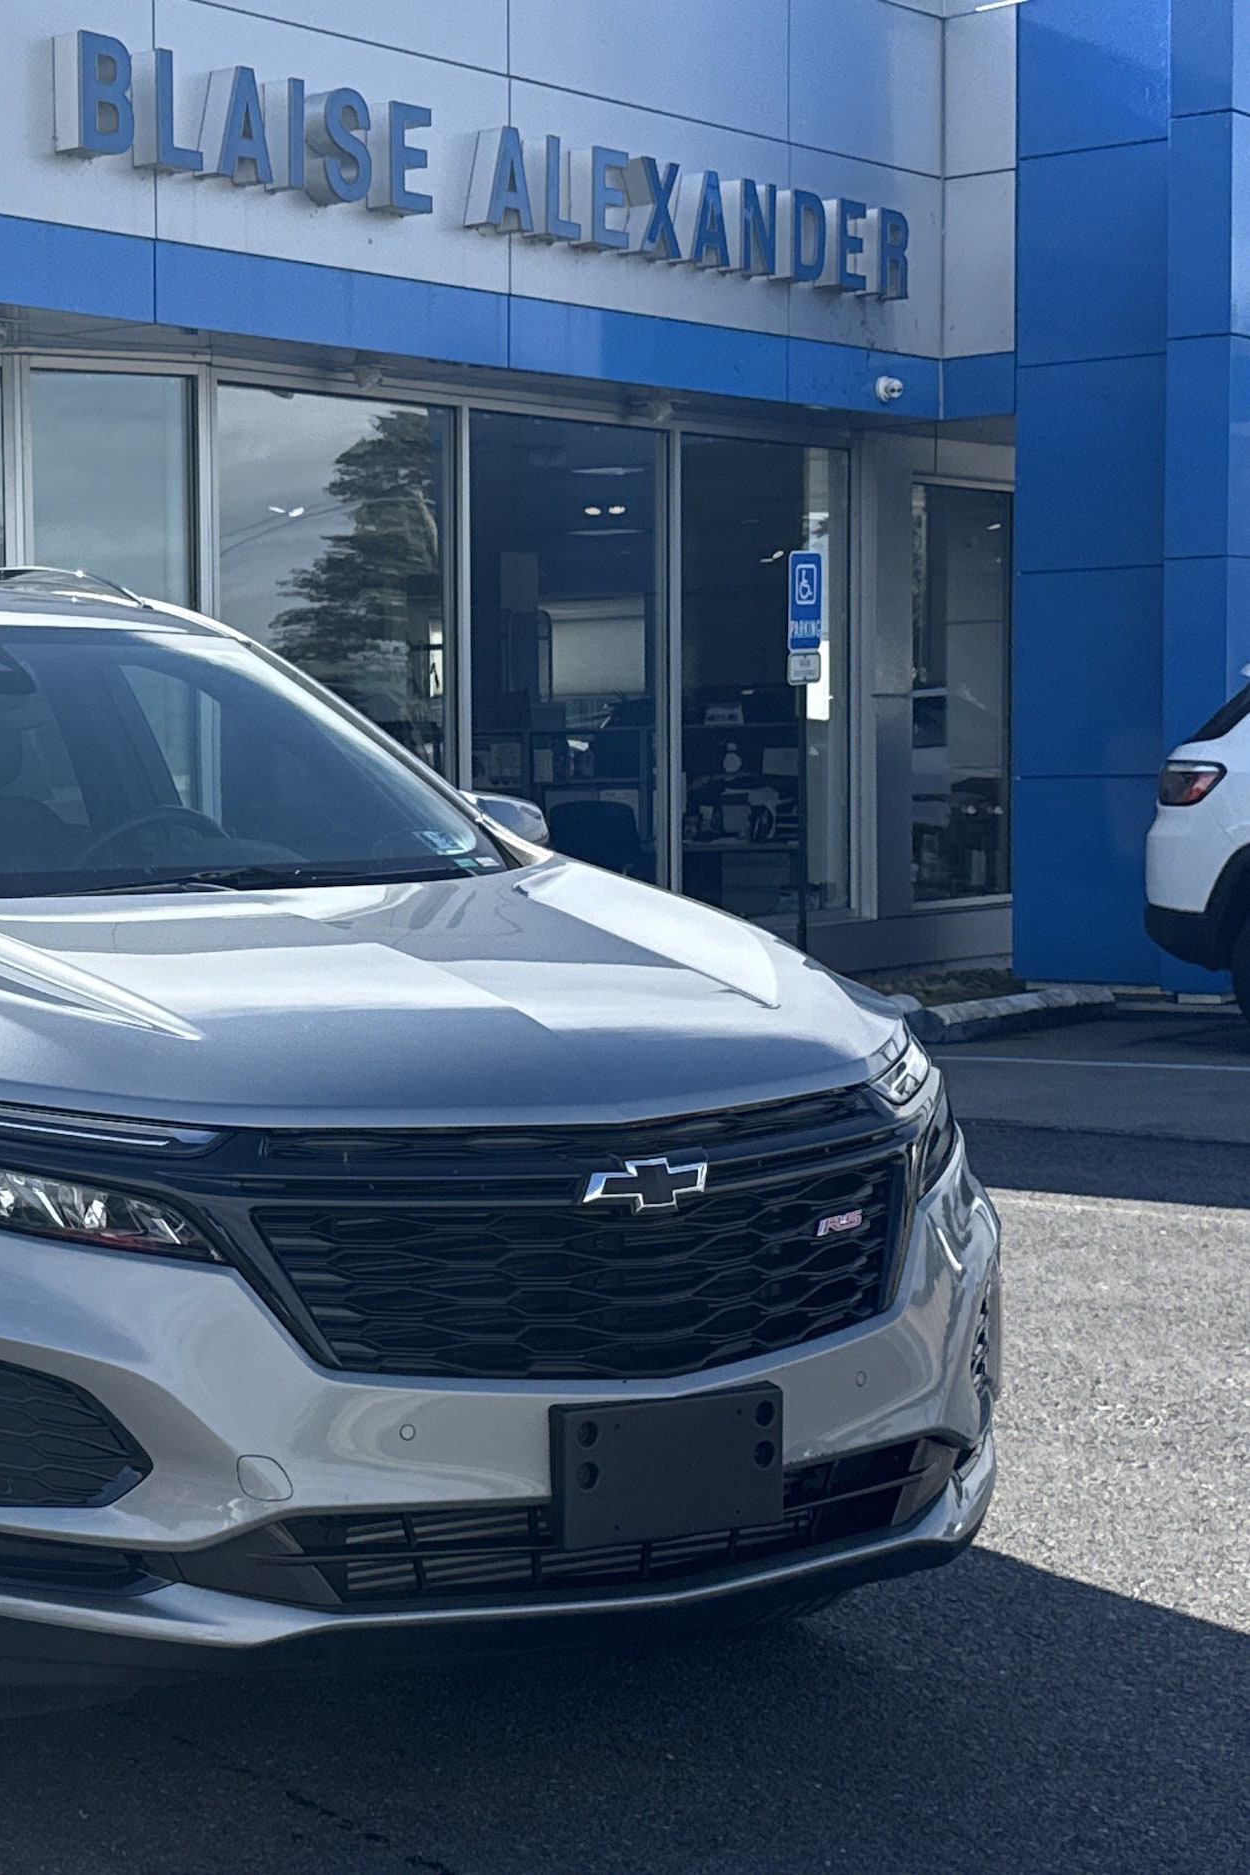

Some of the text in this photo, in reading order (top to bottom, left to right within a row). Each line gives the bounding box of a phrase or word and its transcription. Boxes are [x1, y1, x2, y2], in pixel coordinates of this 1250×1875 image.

[74, 29, 910, 301] BLAISE ALEXANDER
[790, 619, 821, 638] PARKING
[816, 1209, 863, 1237] RS
